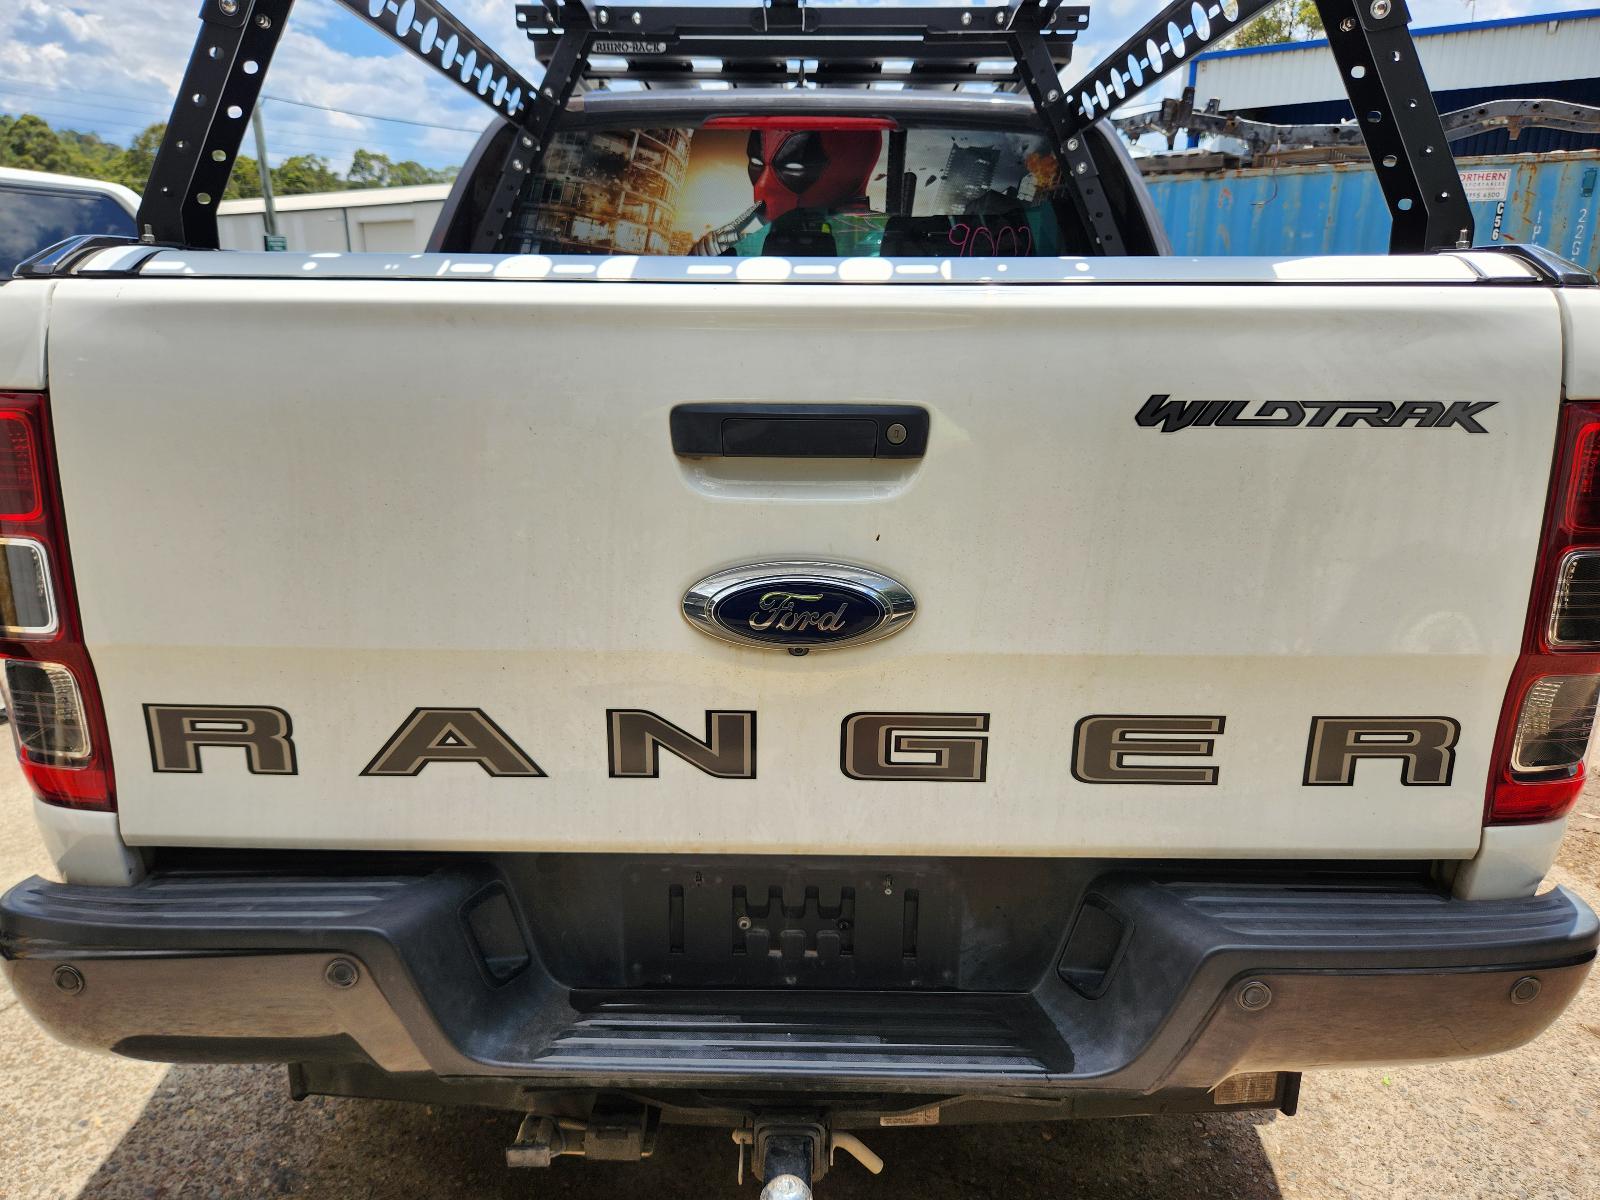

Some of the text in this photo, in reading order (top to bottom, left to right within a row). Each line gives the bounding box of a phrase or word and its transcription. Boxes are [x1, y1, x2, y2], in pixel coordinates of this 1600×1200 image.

[596, 42, 660, 53] RHINO-RACK
[1460, 172, 1507, 181] ORTHERN
[1135, 394, 1499, 433] WILDTRAK
[749, 591, 848, 631] Ford
[142, 703, 1461, 787] RANGER
